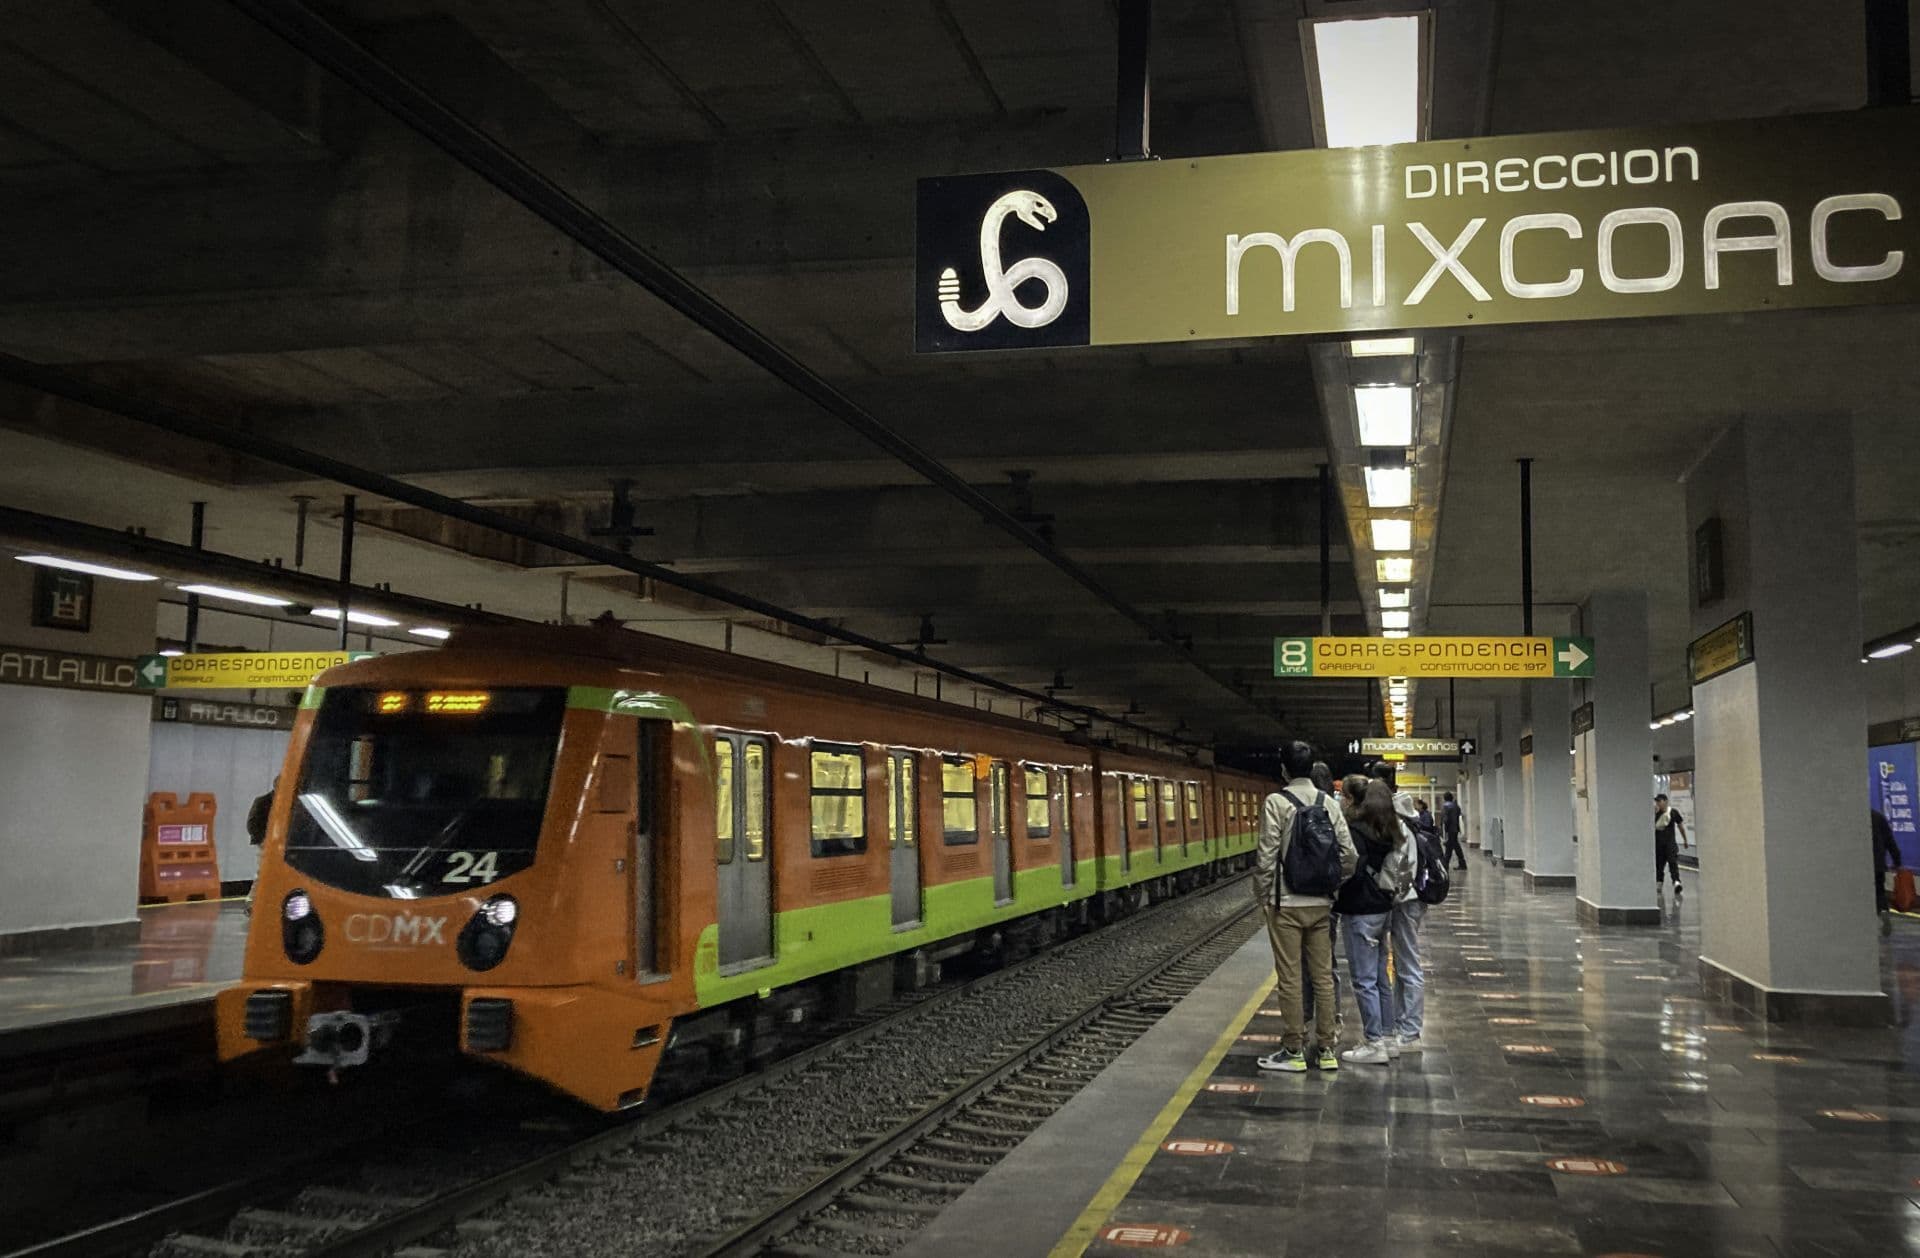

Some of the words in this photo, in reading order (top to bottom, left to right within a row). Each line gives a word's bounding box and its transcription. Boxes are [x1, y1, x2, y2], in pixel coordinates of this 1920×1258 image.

[1405, 146, 1699, 199] DIRECCION
[1225, 193, 1904, 316] MIXCOAC
[1281, 640, 1307, 667] 8
[1318, 643, 1548, 657] CORRESPONDENCIA
[0, 652, 138, 688] ATLALILC
[1319, 662, 1375, 671] GARIBALDI
[1420, 662, 1500, 671] CONSTITUCION
[1503, 662, 1520, 671] DE
[1523, 662, 1547, 671] 1917
[1416, 743, 1425, 752] Y
[1427, 740, 1459, 752] NIÑOS
[442, 851, 499, 884] 24
[344, 912, 448, 945] CDMX
